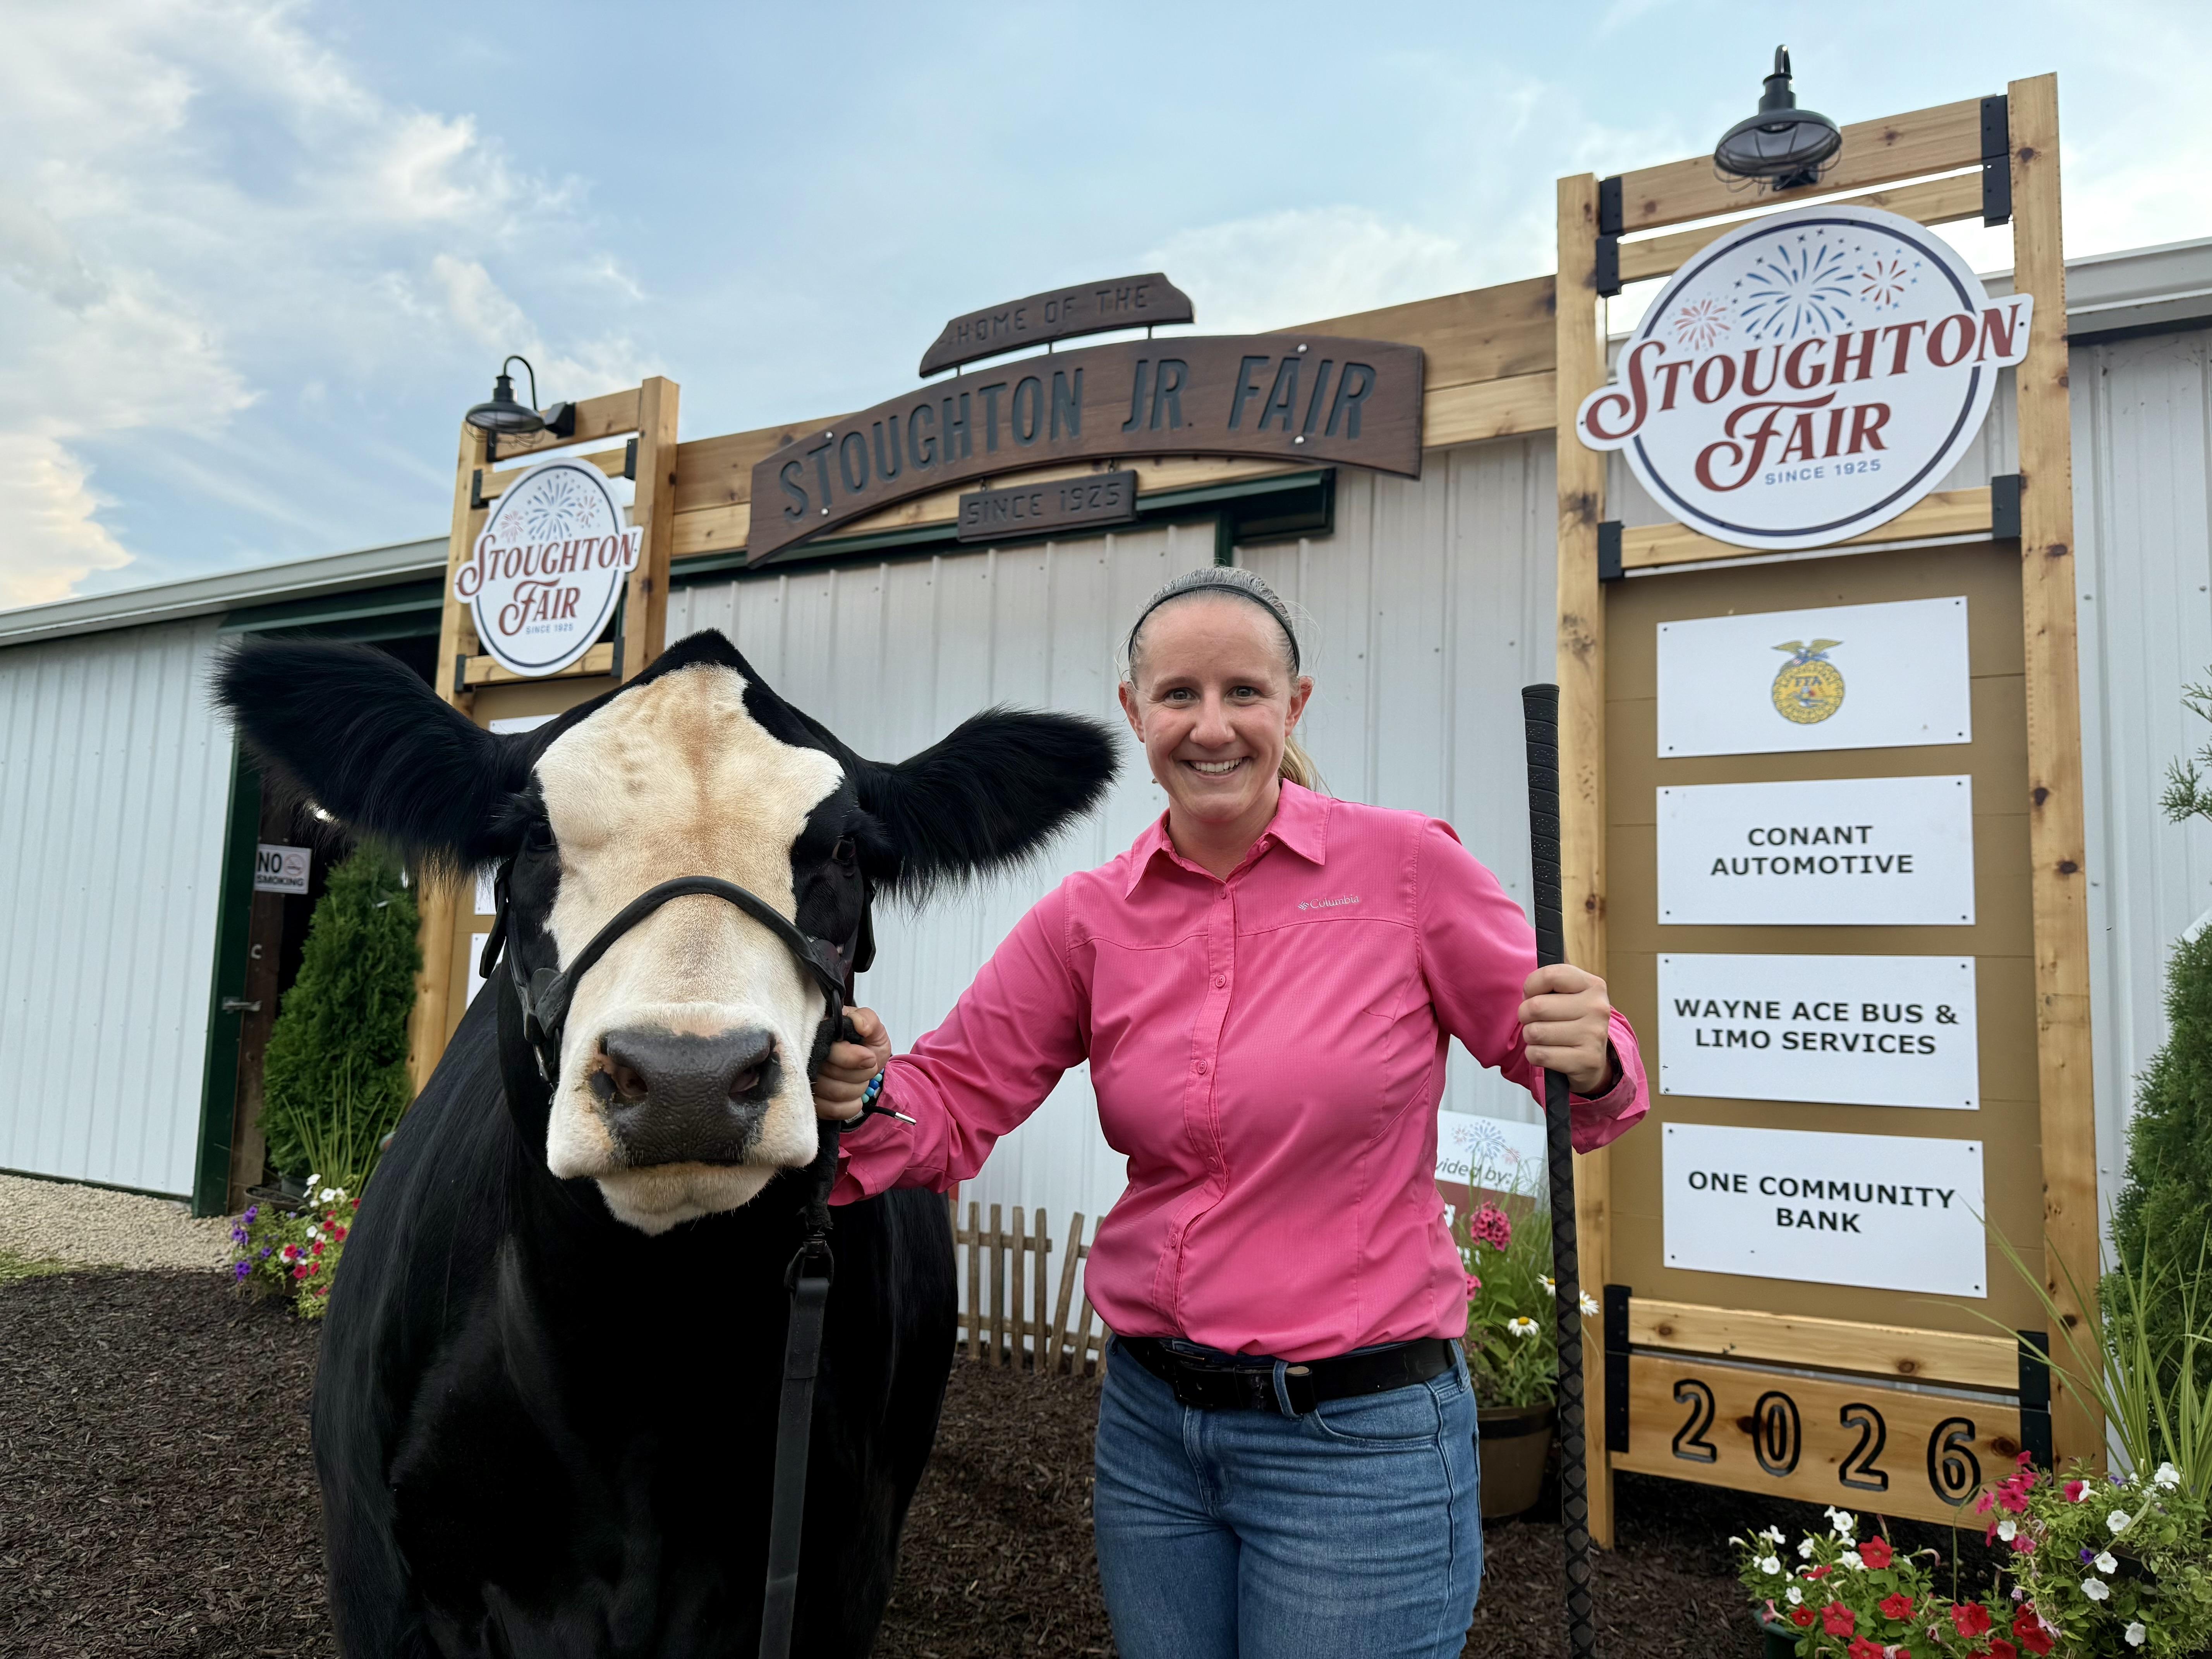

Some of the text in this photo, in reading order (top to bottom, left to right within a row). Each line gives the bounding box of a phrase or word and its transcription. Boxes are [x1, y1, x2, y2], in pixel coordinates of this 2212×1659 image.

[958, 285, 1149, 345] HOME OF THE
[1584, 304, 2021, 440] STOUGHTON
[779, 356, 1376, 522] STOUGHTON JR. FAIR
[1695, 391, 1891, 491] FAIR
[1764, 459, 1881, 485] SINCE 1925
[966, 483, 1121, 526] SINCE 1925
[458, 534, 636, 596] STOUGHTON
[499, 577, 580, 636] FAIR
[526, 622, 574, 635] SINCE 1925
[1748, 825, 1874, 846] CONANT
[258, 852, 282, 873] NO
[1711, 855, 1913, 876] AUTOMOTIVE
[256, 874, 304, 886] SMOKING
[1310, 894, 1359, 908] Columbia
[1674, 999, 1959, 1024] WAYNE ACE BUS &
[1696, 1029, 1936, 1054] LIMO SERVICES
[1688, 1171, 1956, 1209] ONE COMMUNITY
[1777, 1208, 1861, 1233] BANK
[1672, 1379, 1981, 1506] 2026
